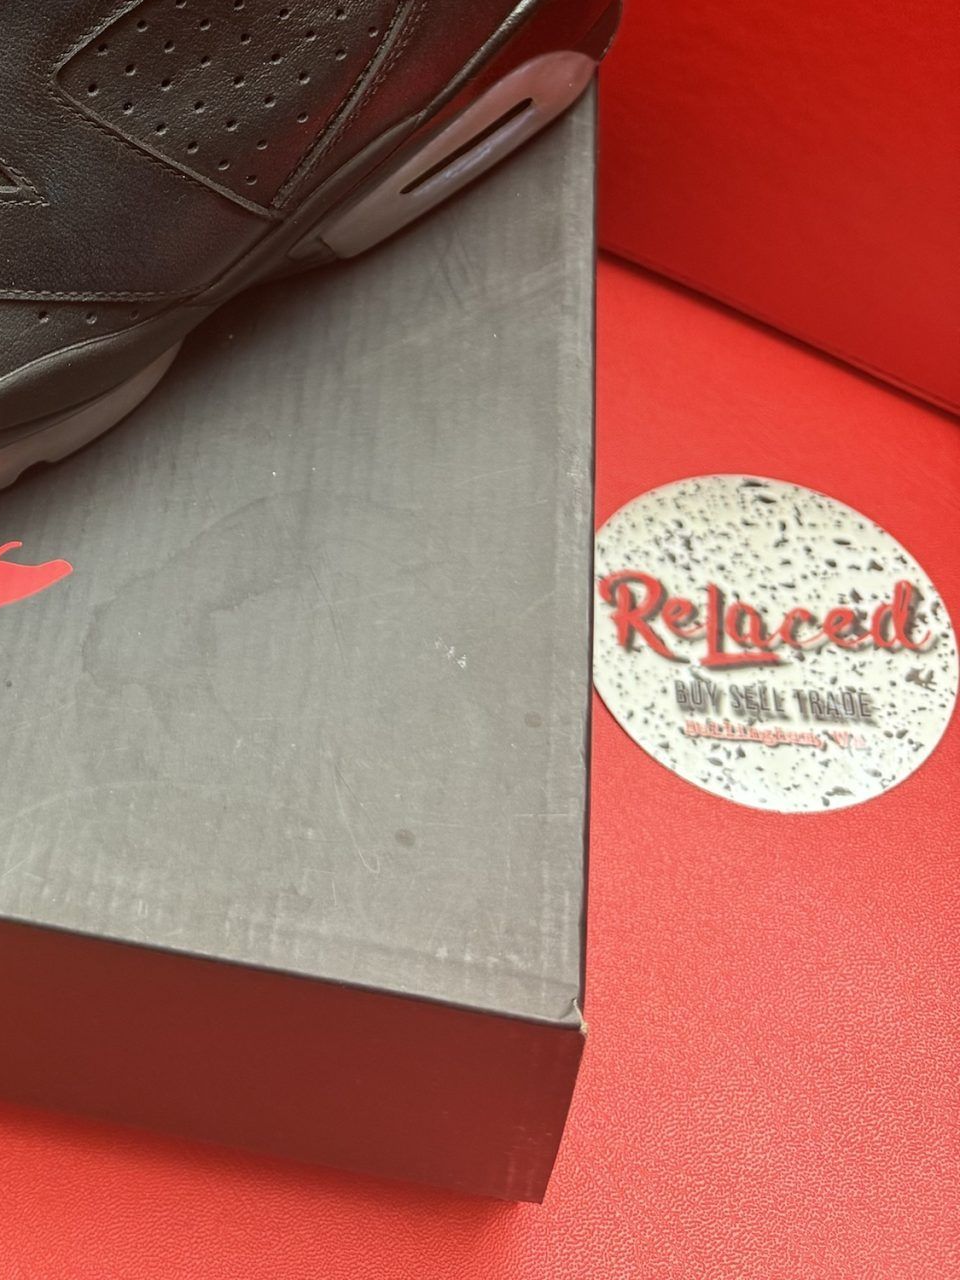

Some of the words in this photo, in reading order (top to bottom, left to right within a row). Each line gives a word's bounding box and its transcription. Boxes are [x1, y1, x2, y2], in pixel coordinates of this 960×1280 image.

[674, 679, 719, 708] BUY
[728, 683, 788, 715] SELL
[792, 687, 874, 719] TRADE
